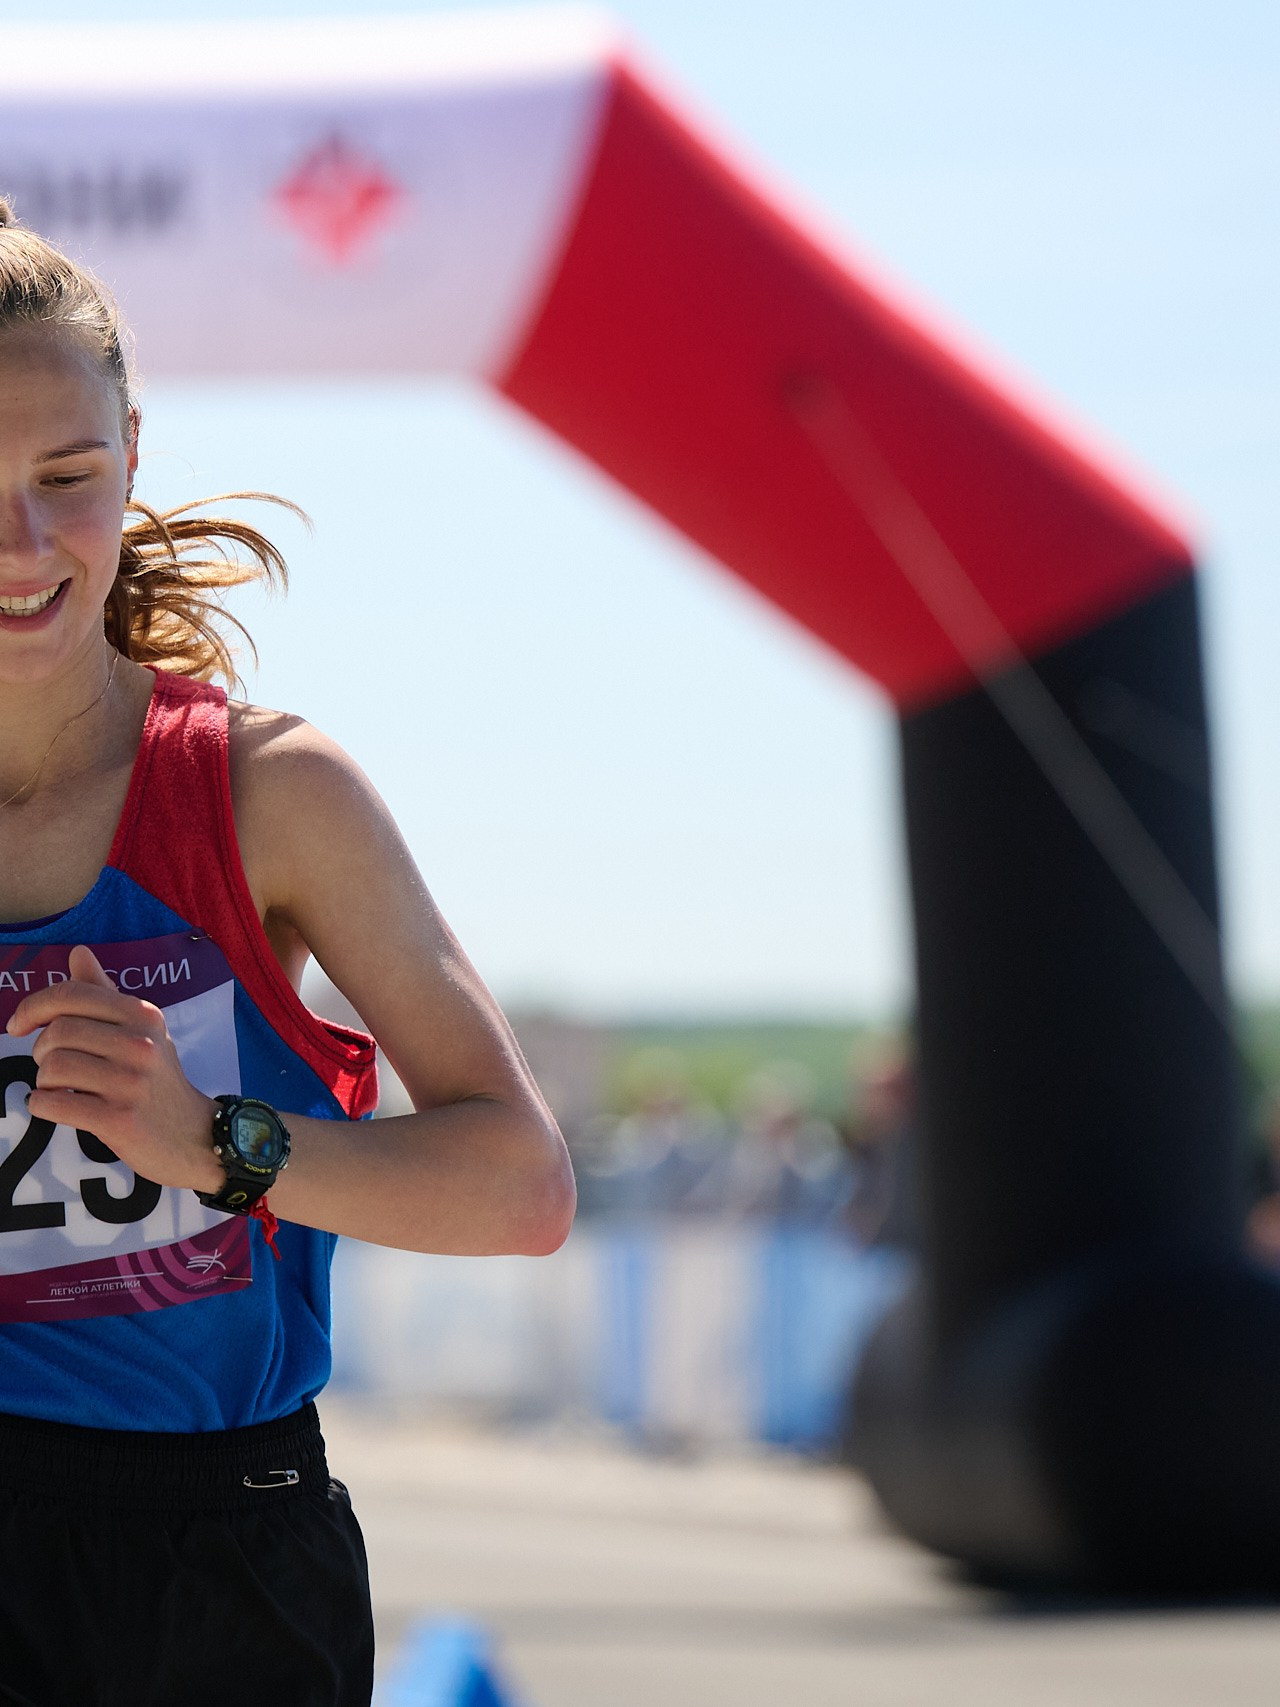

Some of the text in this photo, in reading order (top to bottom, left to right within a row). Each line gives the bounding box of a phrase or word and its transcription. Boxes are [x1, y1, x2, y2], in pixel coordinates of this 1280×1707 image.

[47, 958, 192, 992] РСИИ
[50, 1284, 89, 1296] ЛЕГКОЙ
[90, 1280, 141, 1293] АТЛЕТИКИ
